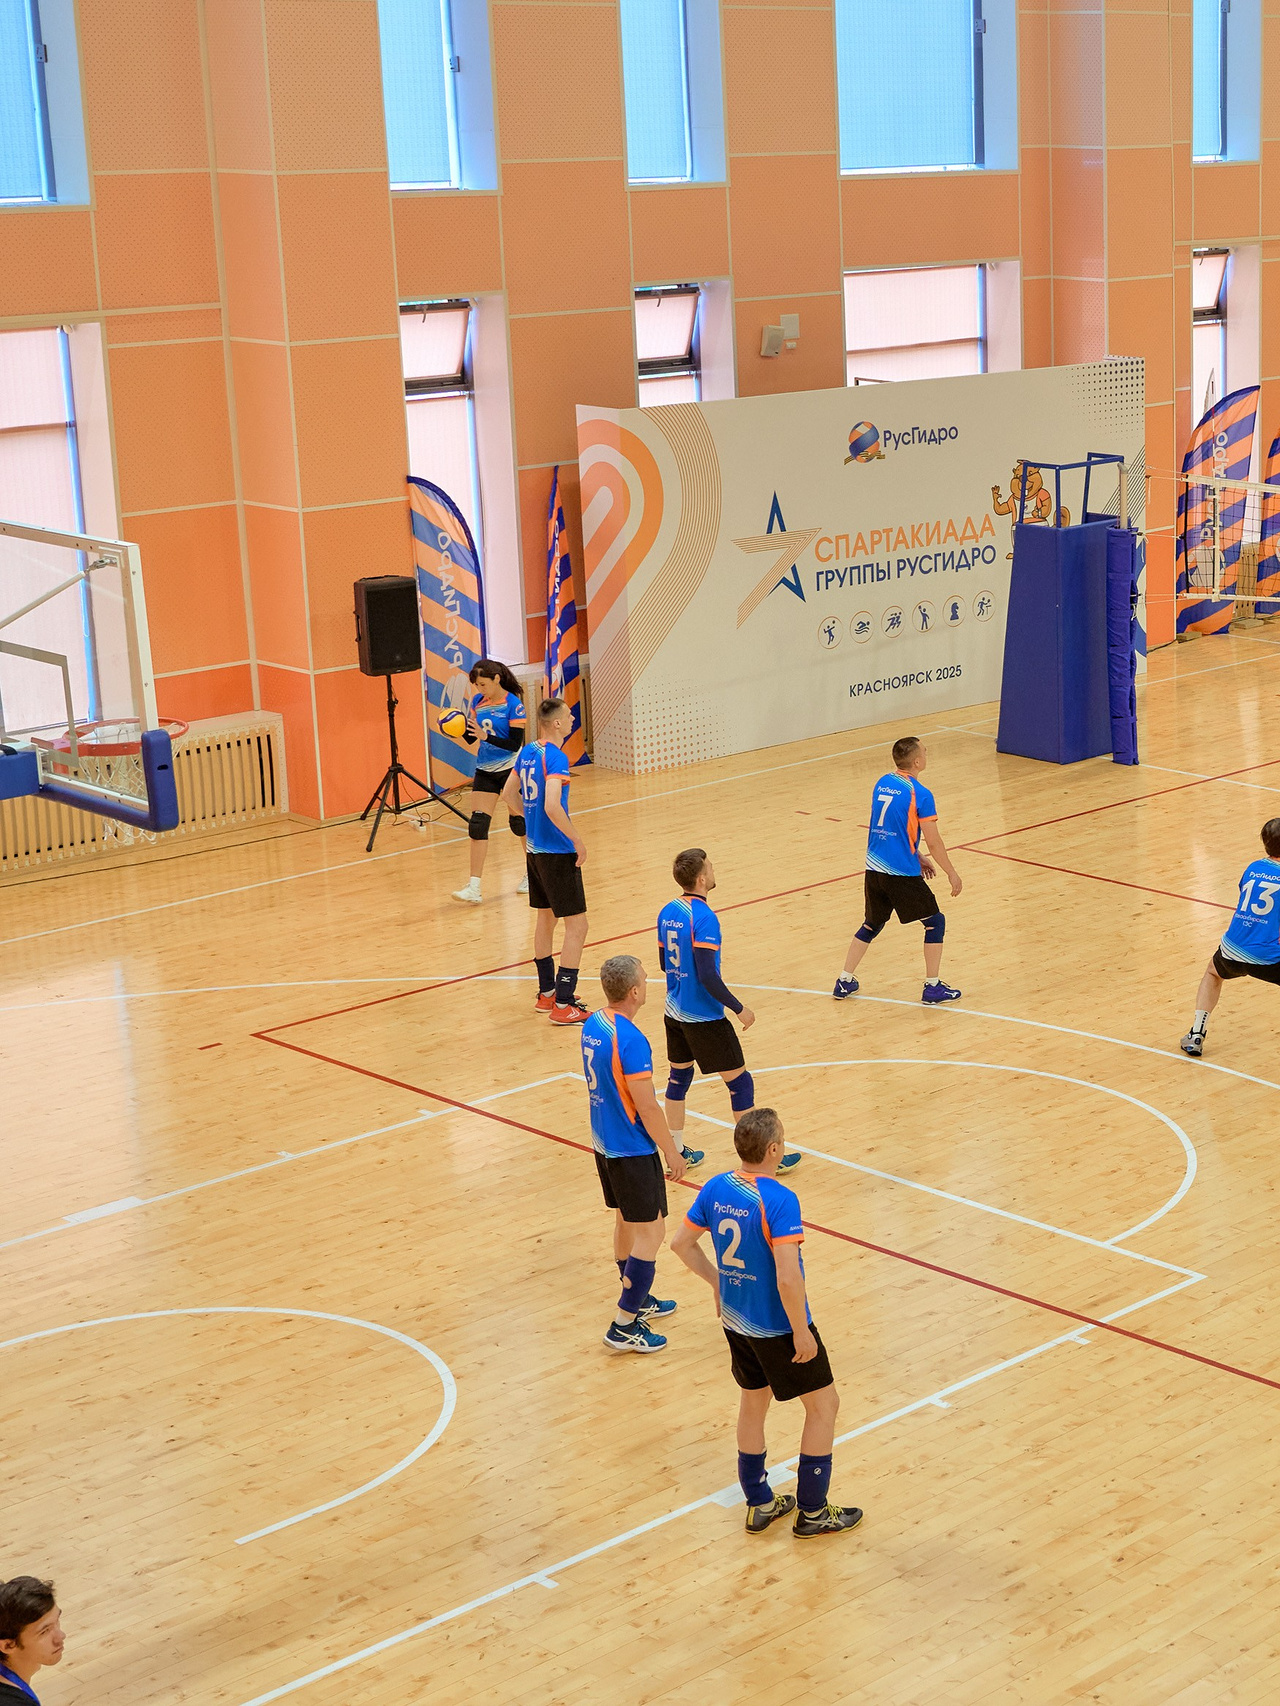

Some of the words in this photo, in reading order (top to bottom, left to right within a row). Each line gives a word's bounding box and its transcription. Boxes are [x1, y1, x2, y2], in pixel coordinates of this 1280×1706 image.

[883, 426, 958, 450] РусГидро
[815, 513, 996, 563] СПАРТАКИАДА
[816, 561, 891, 592] ГРУППЫ
[897, 545, 996, 579] РУСГИДРО
[849, 670, 933, 697] КРАСНОЯРСК
[936, 665, 962, 681] 2025
[877, 794, 893, 826] 7
[667, 930, 680, 968] 5
[584, 1046, 598, 1091] 3
[714, 1201, 749, 1218] РусГидро
[718, 1218, 746, 1269] 2
[728, 1277, 742, 1287] ГЭС
